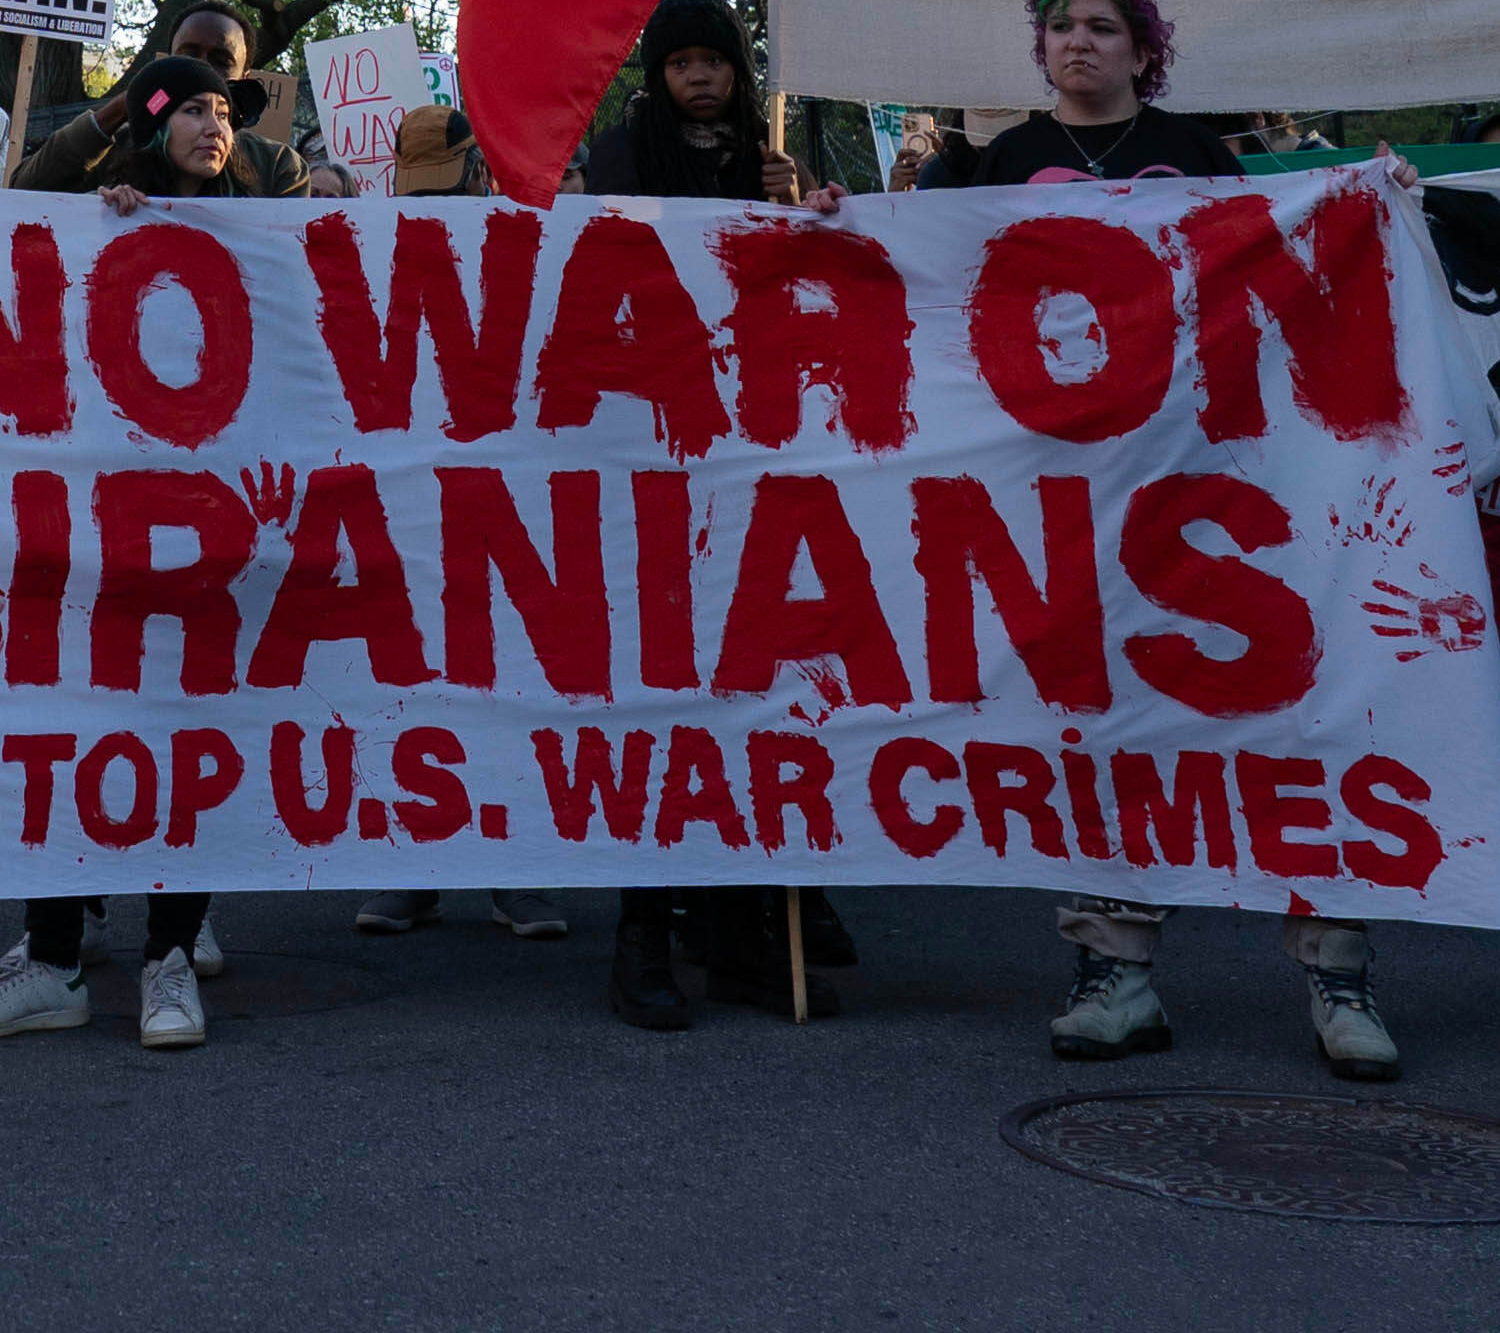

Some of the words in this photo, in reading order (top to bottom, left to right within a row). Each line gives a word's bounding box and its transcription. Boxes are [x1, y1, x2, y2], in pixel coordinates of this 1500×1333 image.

[3, 11, 49, 28] SOCIALISM
[56, 17, 105, 37] LIBERATION
[322, 48, 380, 101] NO
[302, 209, 922, 461] WAR
[962, 185, 1414, 445] ON
[3, 463, 1324, 719] IRANIANS
[269, 723, 510, 847] U.S.
[531, 725, 843, 855] WAR
